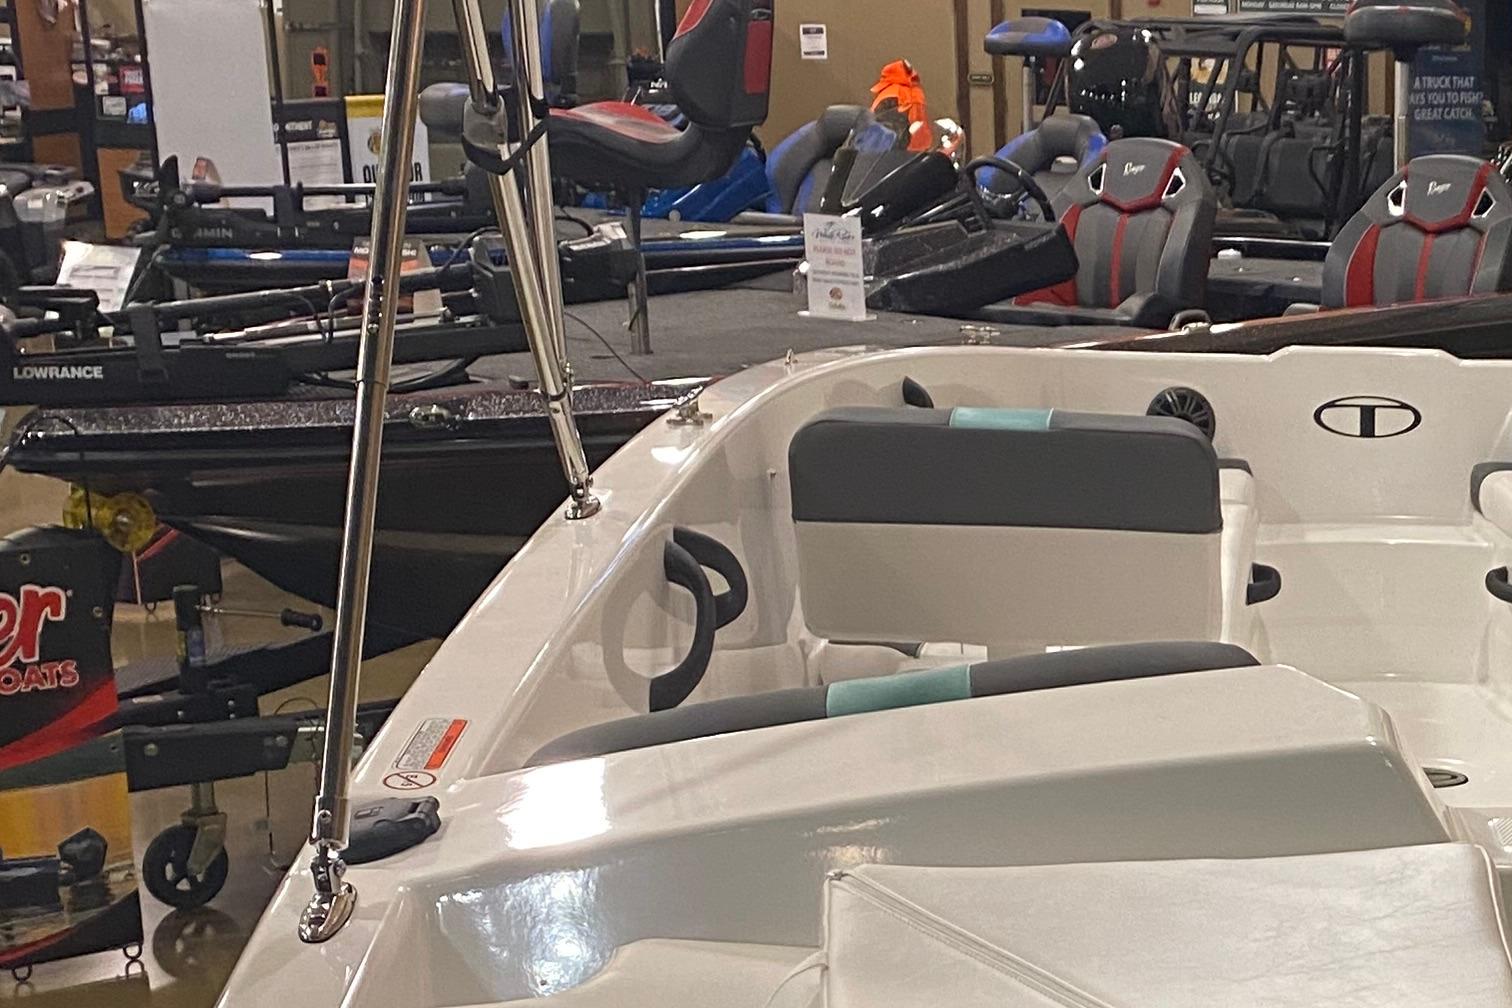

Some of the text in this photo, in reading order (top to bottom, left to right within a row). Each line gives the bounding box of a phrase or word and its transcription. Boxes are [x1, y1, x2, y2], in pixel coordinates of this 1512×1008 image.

[1422, 76, 1452, 88] TRUCK
[1453, 76, 1475, 88] THAT
[1408, 92, 1426, 104] AYS
[1428, 92, 1446, 104] YOU
[1447, 91, 1459, 104] TO
[1414, 107, 1442, 120] GREAT
[13, 366, 104, 380] LOWRANCE
[0, 659, 80, 695] OATS
